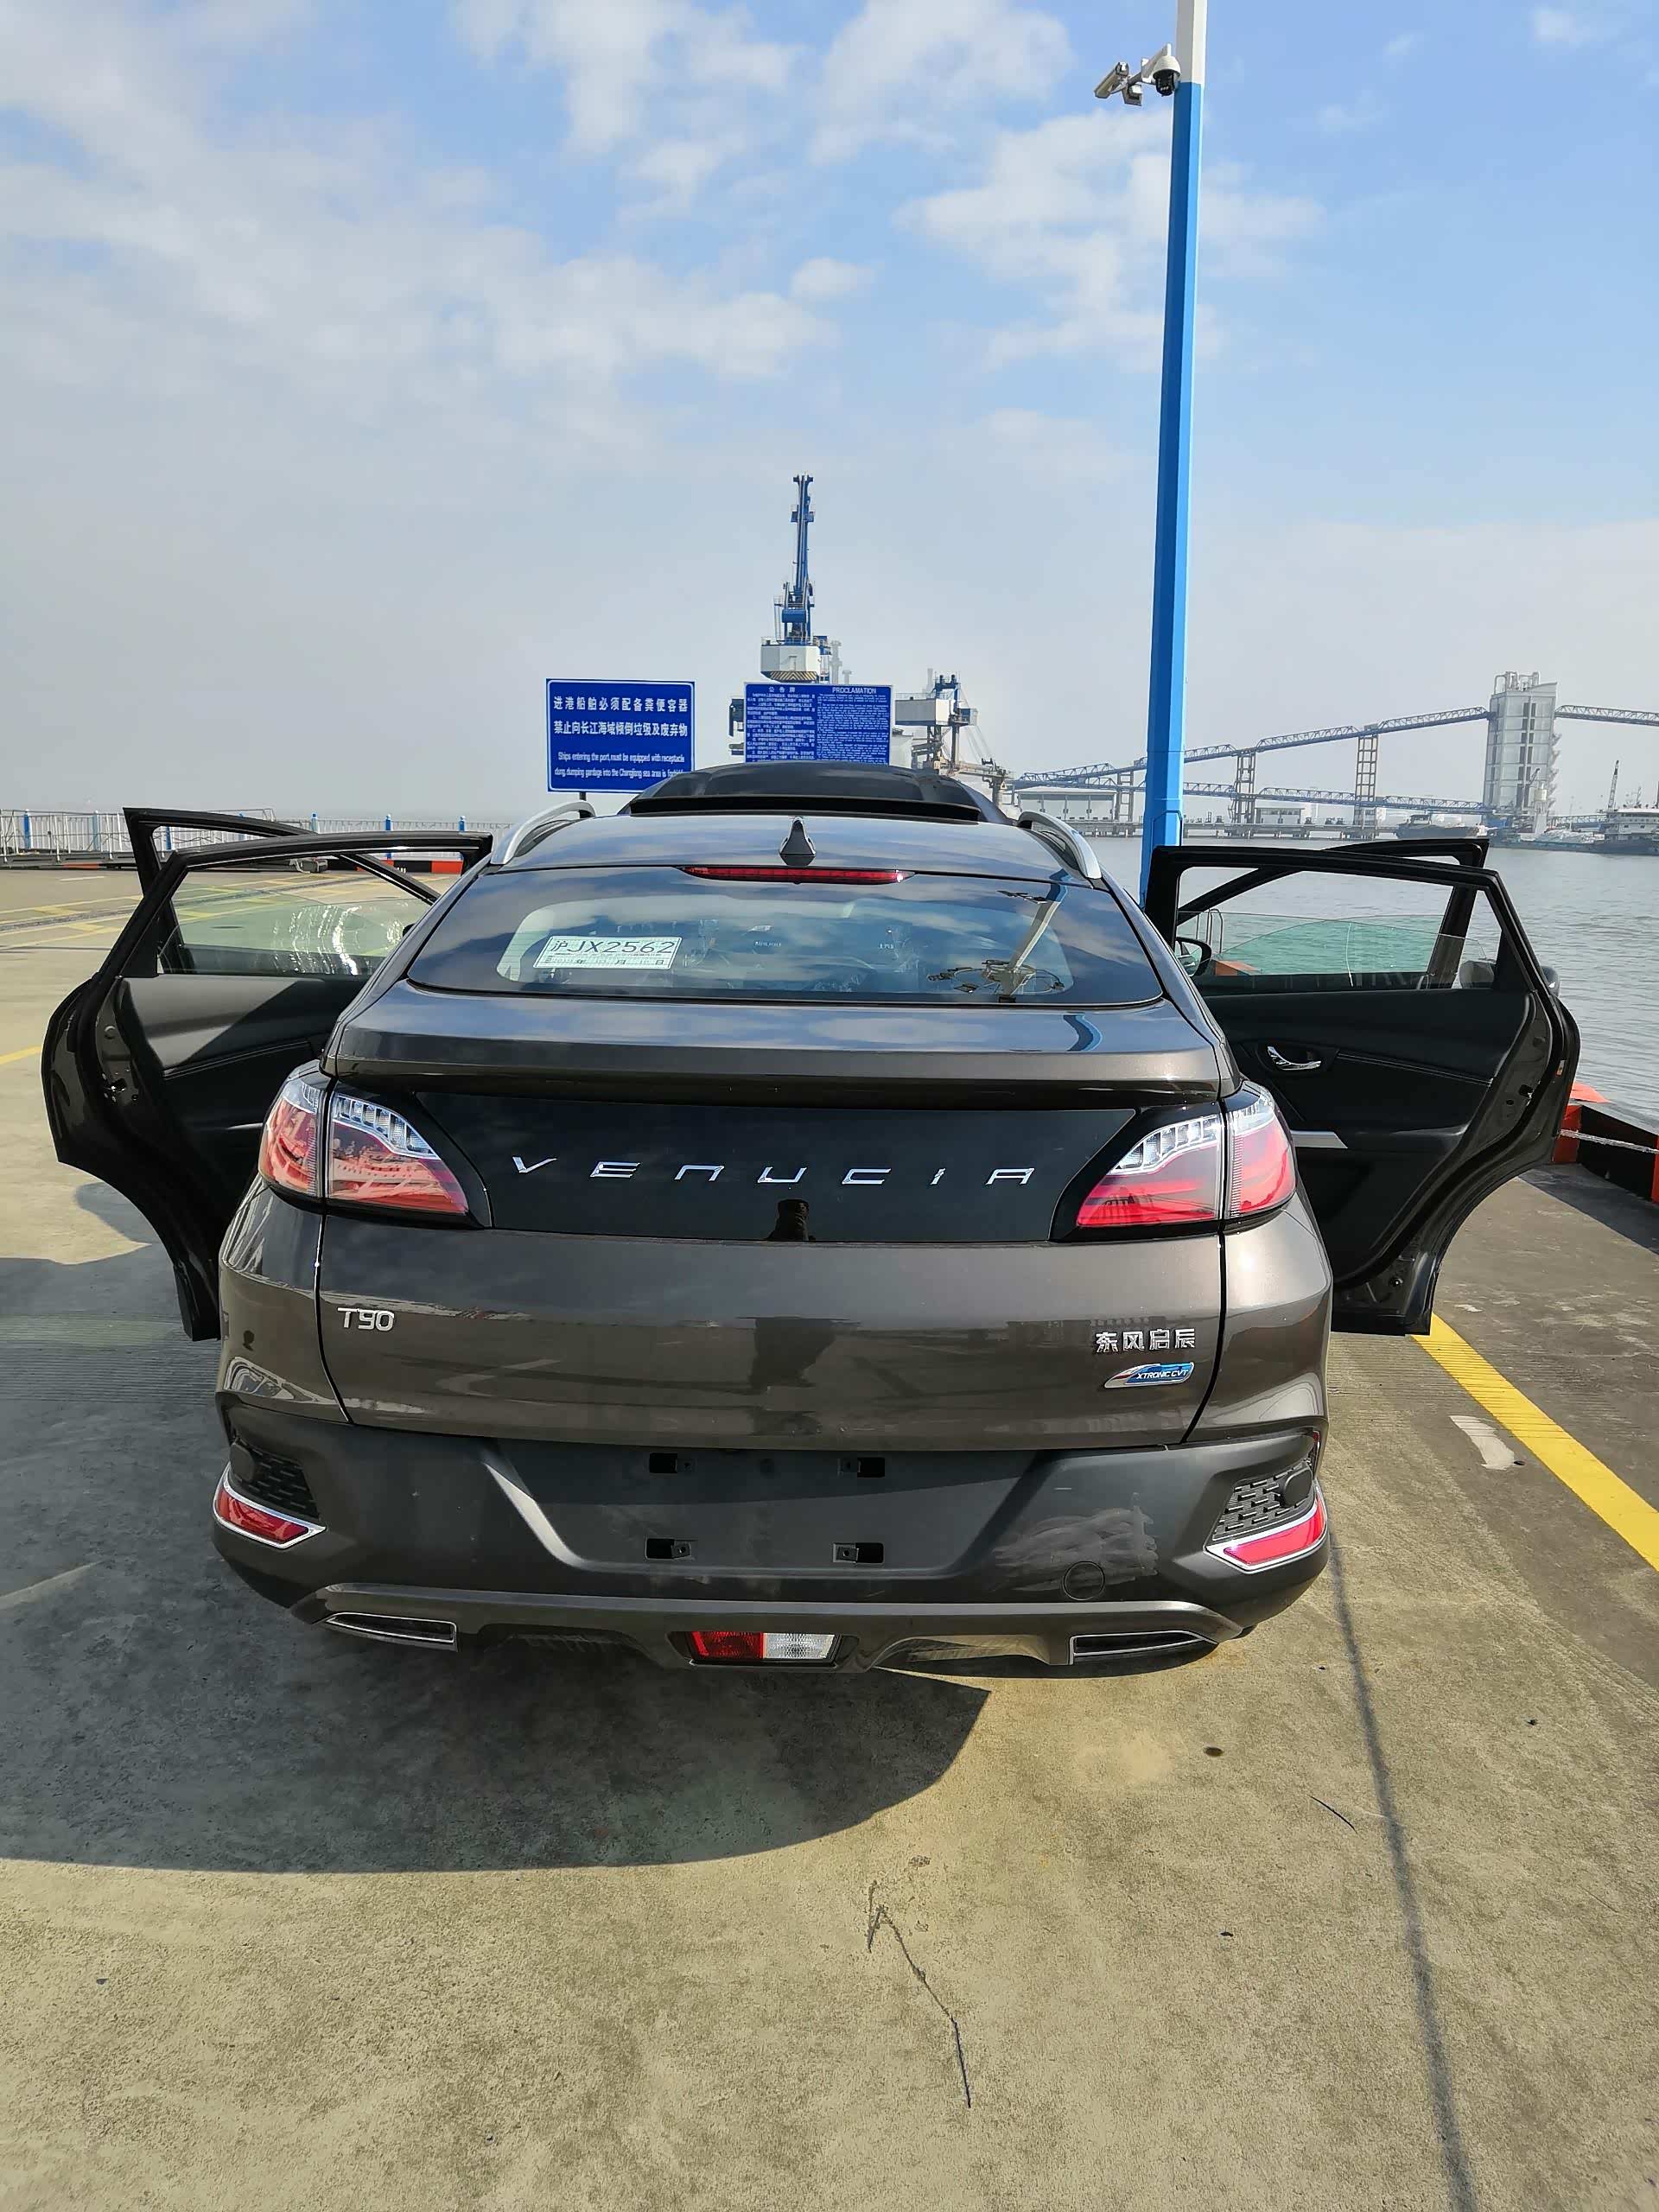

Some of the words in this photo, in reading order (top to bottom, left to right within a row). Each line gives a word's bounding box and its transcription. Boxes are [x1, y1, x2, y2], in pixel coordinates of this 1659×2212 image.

[554, 696, 688, 712] 进港船舶必须配备粪便容器
[554, 721, 688, 737] 禁止向长江海域倾倒垃圾及废弃物
[558, 752, 571, 762] Ships
[572, 753, 590, 762] entering
[629, 753, 651, 764] equipped
[662, 769, 666, 778] is
[338, 1307, 394, 1331] T90
[1095, 1329, 1195, 1353] 东风启辰
[1136, 1371, 1171, 1380] XTRONIC
